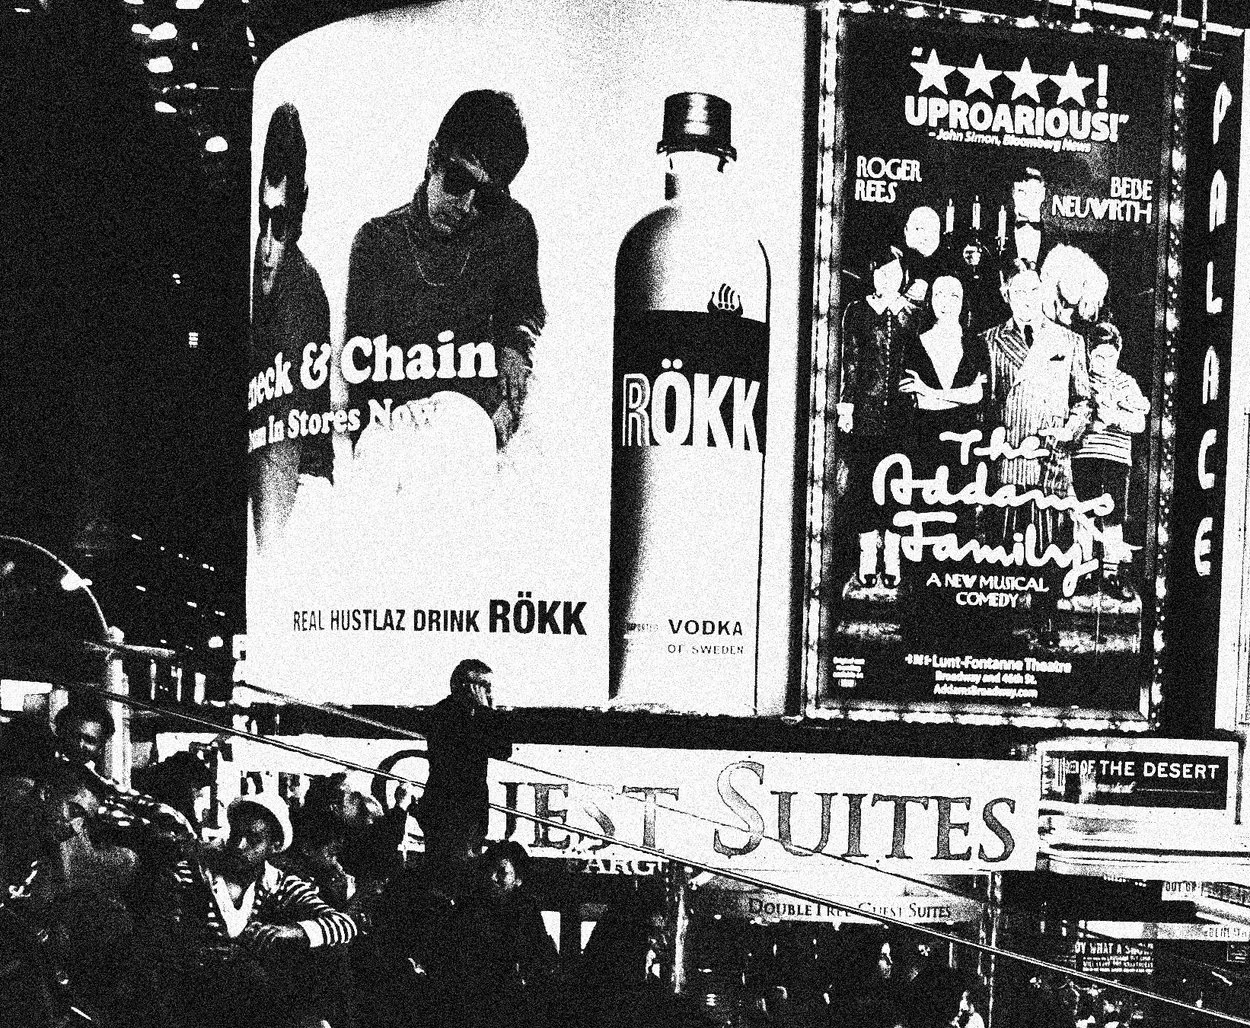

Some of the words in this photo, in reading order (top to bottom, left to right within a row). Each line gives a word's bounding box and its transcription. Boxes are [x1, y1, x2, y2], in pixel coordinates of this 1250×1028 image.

[856, 156, 922, 182] ROGER
[854, 180, 897, 203] REES
[1193, 81, 1232, 577] PALACE
[300, 342, 331, 390] &
[341, 330, 498, 384] Chain
[622, 358, 762, 453] RÖKK
[287, 408, 360, 439] Stores
[938, 427, 1049, 466] The
[873, 453, 1115, 517] Addams
[892, 511, 1099, 597] Family
[926, 574, 942, 587] A
[945, 573, 976, 590] NEW
[979, 575, 1050, 593] MUSICAL
[955, 592, 1020, 608] COMEDY
[293, 609, 324, 633] REAL
[330, 609, 406, 633] HUSTLAZ
[413, 609, 480, 634] DRINK
[488, 591, 588, 636] RÖKK
[668, 618, 743, 636] VODKA
[690, 645, 744, 656] SWEDEN
[932, 655, 1021, 673] Lunt-Fontanne
[1023, 657, 1072, 674] Theatre
[935, 670, 980, 685] Broadway
[1100, 759, 1135, 777] THE
[1143, 762, 1220, 780] DESERT
[713, 760, 1016, 864] SUITES
[908, 901, 952, 919] SUITES
